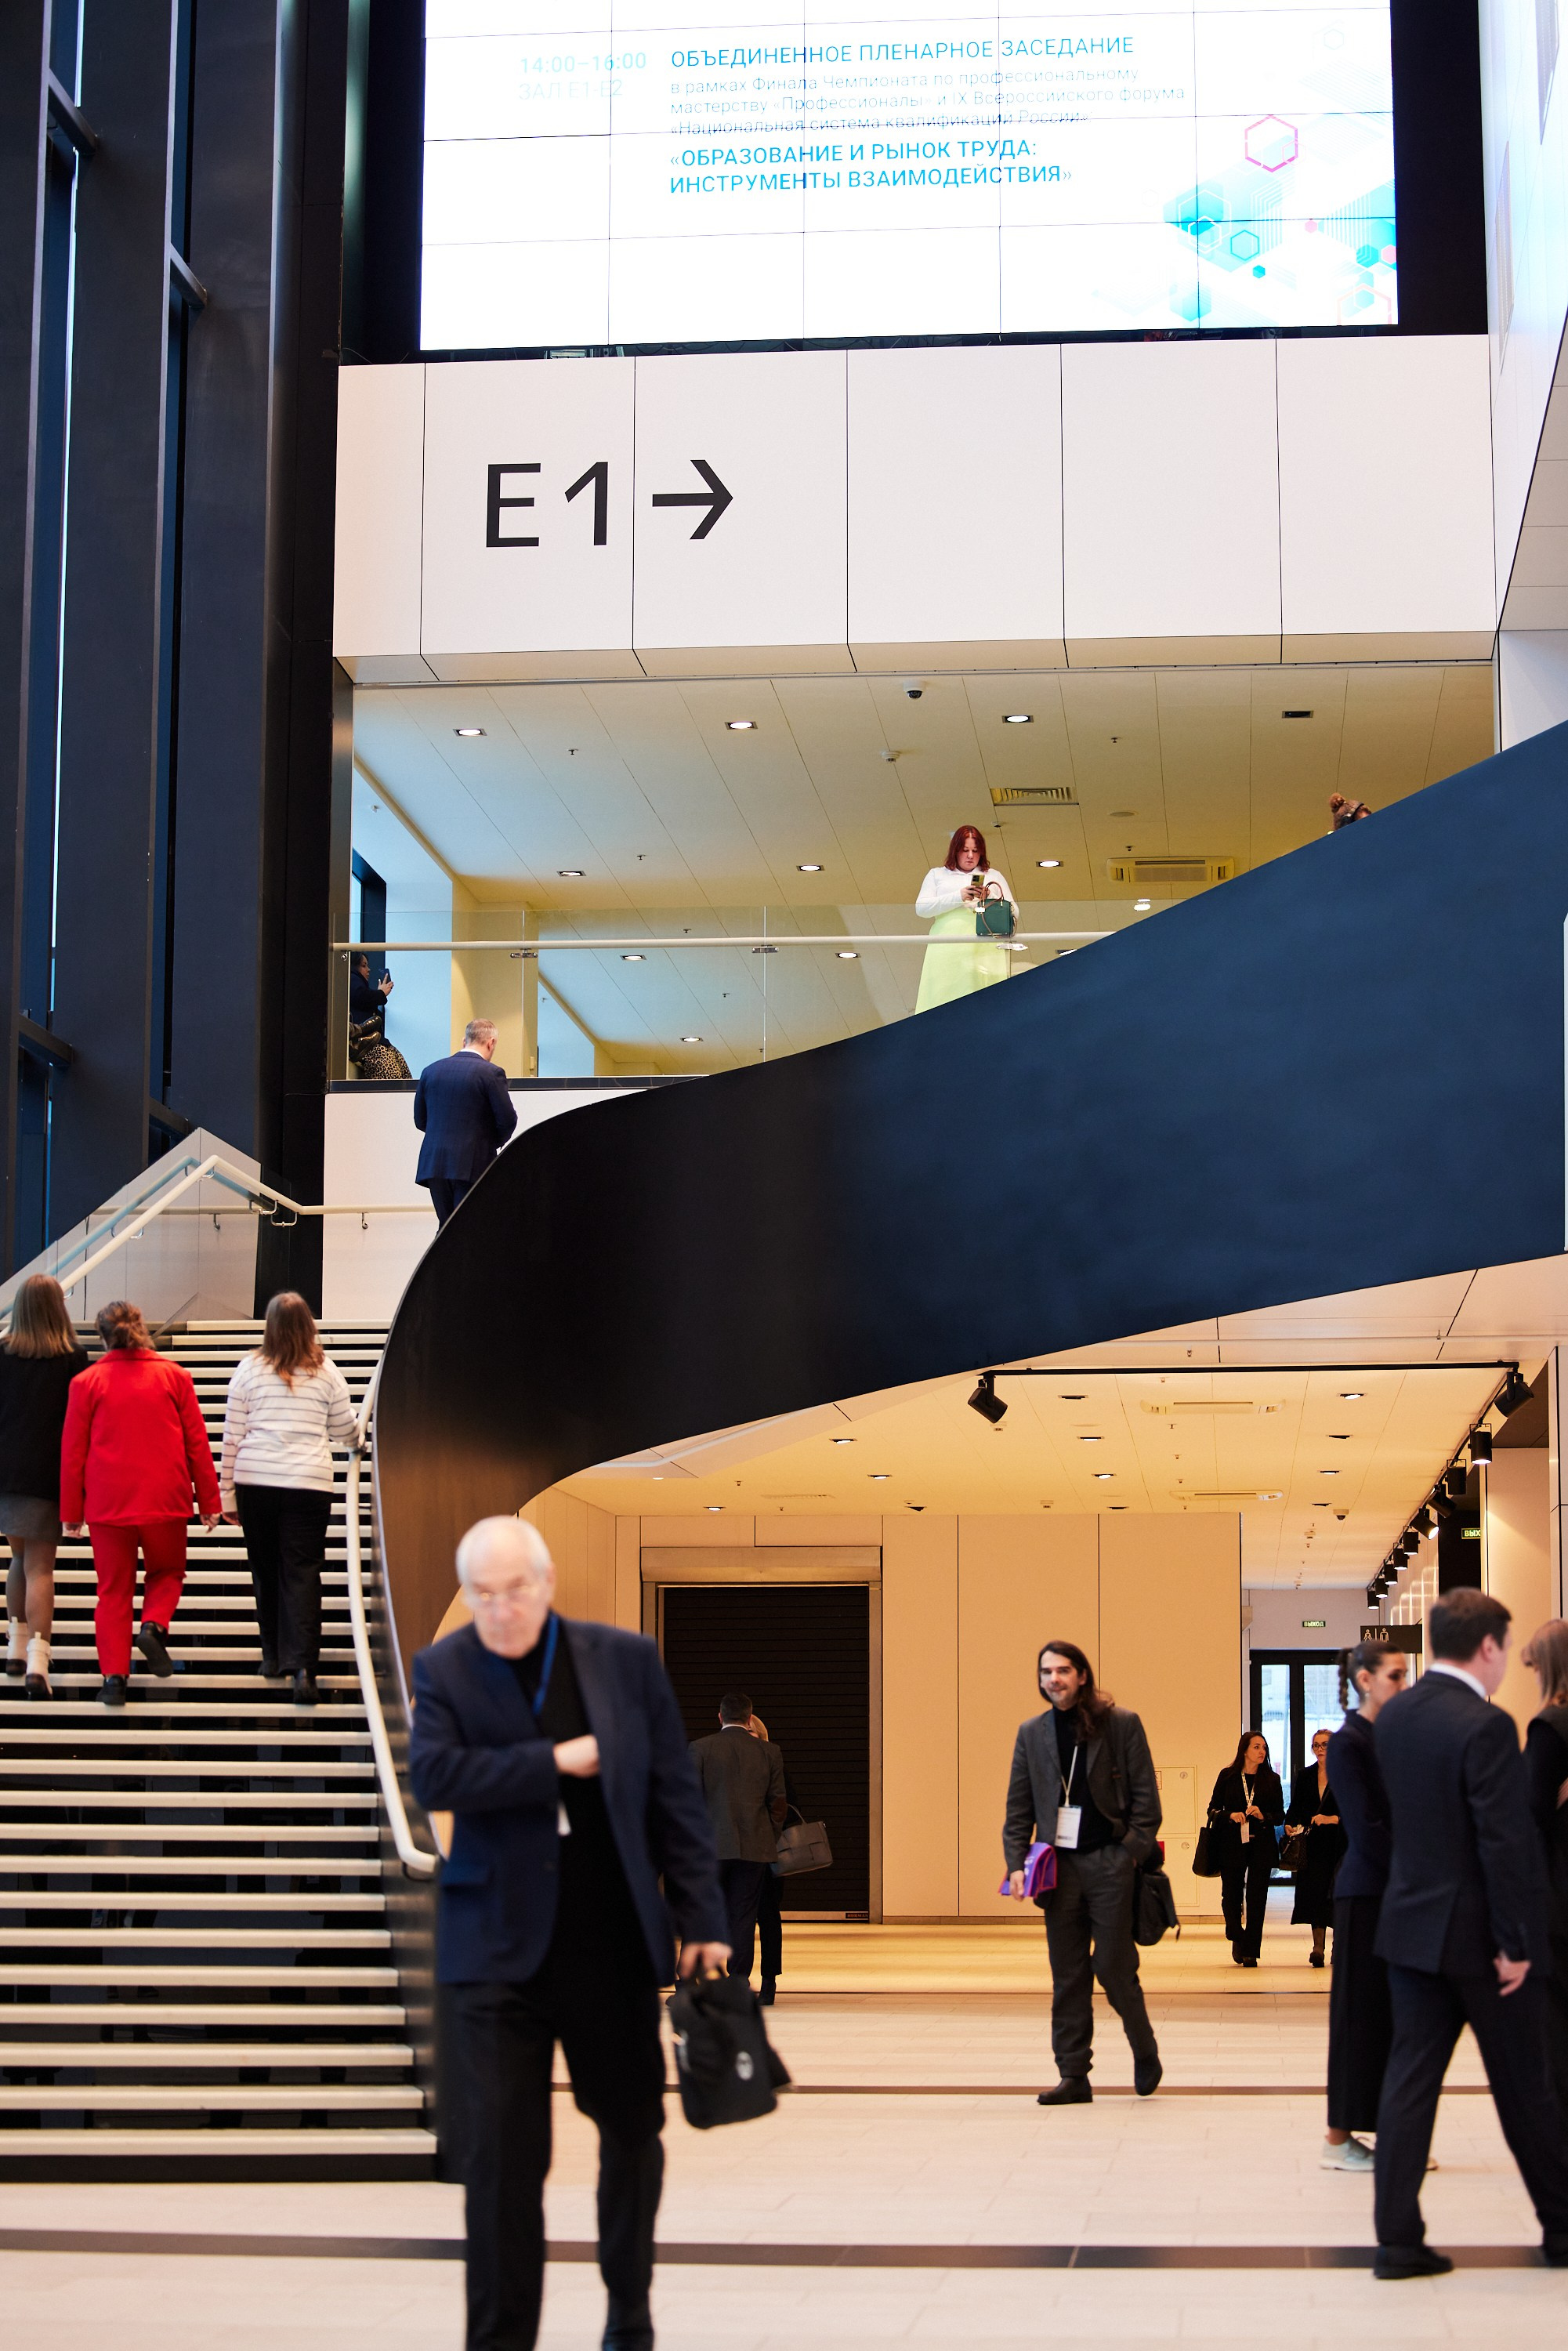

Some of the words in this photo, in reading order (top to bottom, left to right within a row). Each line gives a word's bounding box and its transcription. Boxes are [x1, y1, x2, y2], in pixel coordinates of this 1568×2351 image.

[671, 45, 852, 68] ОБЪЕДИНЕННОЕ
[860, 41, 993, 62] ПЛЕНАРНОЕ
[1001, 37, 1133, 58] ЗАСЕДАНИЕ
[518, 82, 561, 100] ЗАЛ
[671, 83, 679, 93] в
[686, 81, 747, 96] рамках
[752, 77, 817, 92] Финала
[824, 74, 927, 89] Чемпионата
[934, 74, 953, 85] по
[959, 68, 1139, 87] профессиональному
[671, 101, 768, 115] мастерству
[938, 94, 946, 105] и
[953, 92, 968, 105] IX
[1120, 86, 1185, 103] форума
[811, 117, 879, 130] система
[671, 144, 842, 166] «ОБРАЗОВАНИЕ
[850, 144, 864, 161] И
[871, 141, 951, 160] РЫНОК
[958, 139, 1037, 160] ТРУДА:
[670, 169, 840, 193] ИНСТРУМЕНТЫ
[849, 163, 1071, 188] ВЗАИМОДЕЙСТВИЯ»
[486, 461, 609, 548] E1
